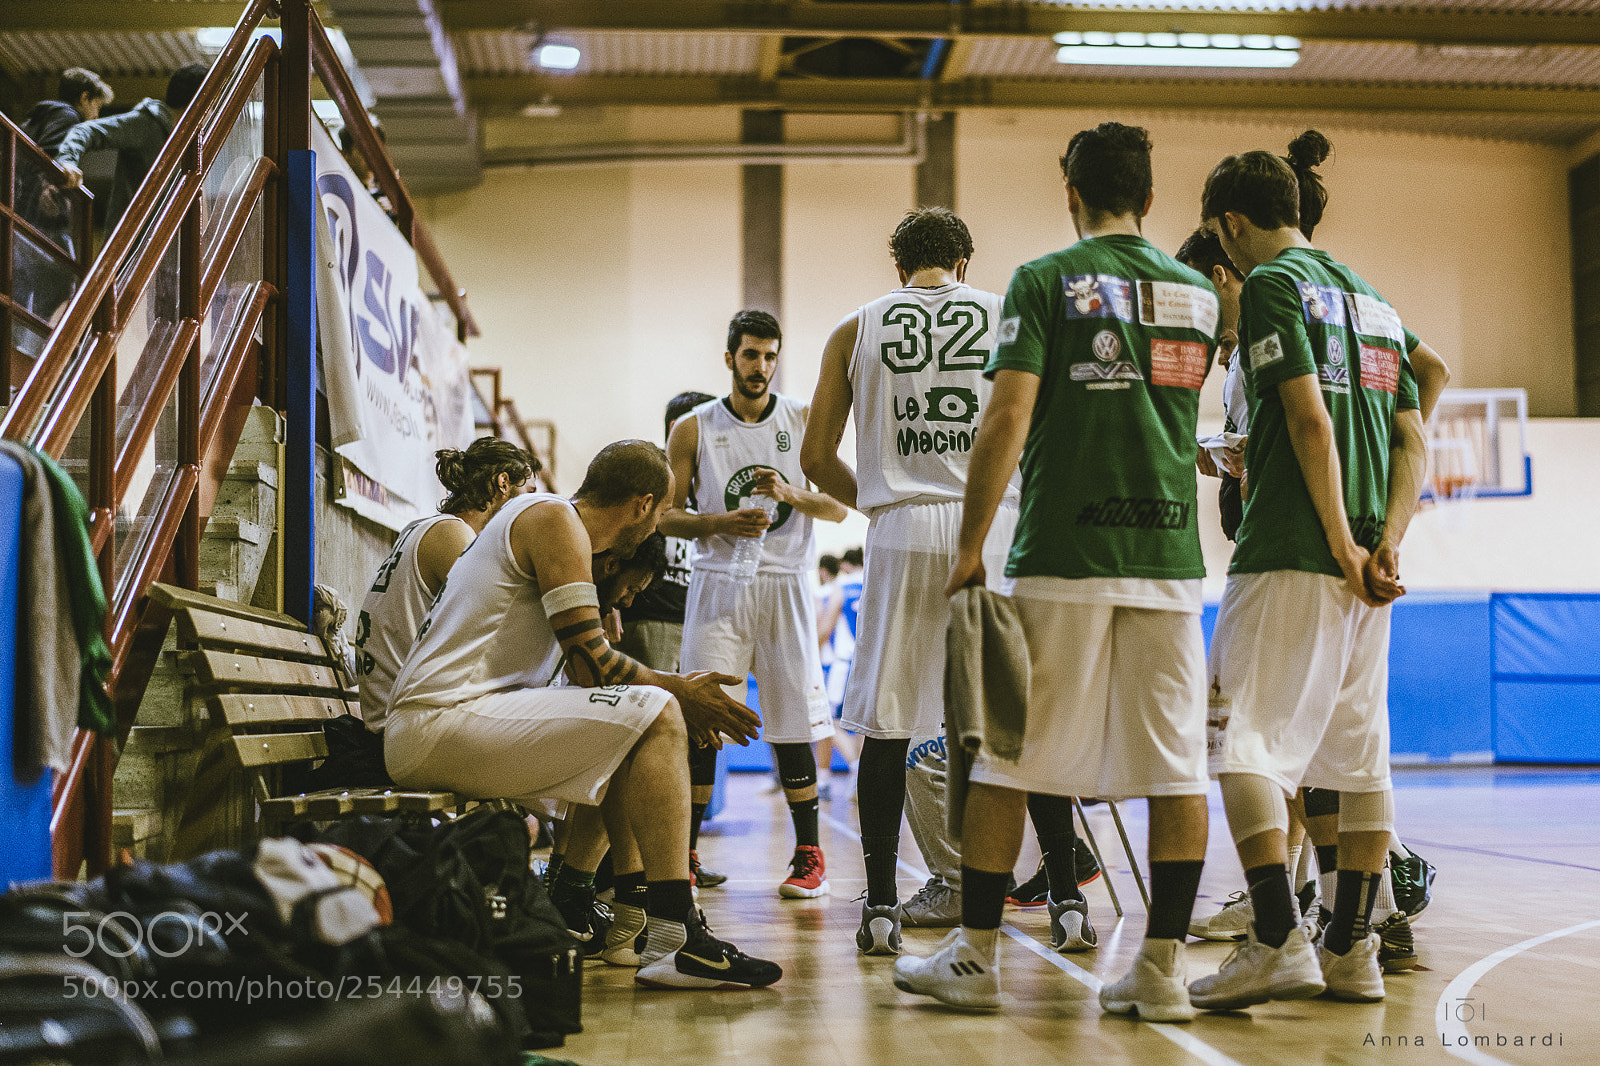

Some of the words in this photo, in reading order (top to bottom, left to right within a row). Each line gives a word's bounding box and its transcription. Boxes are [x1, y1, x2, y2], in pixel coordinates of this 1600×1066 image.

[881, 301, 989, 374] 32
[893, 395, 920, 421] Le
[776, 430, 791, 453] 9
[1075, 496, 1190, 530] #GOGREEN
